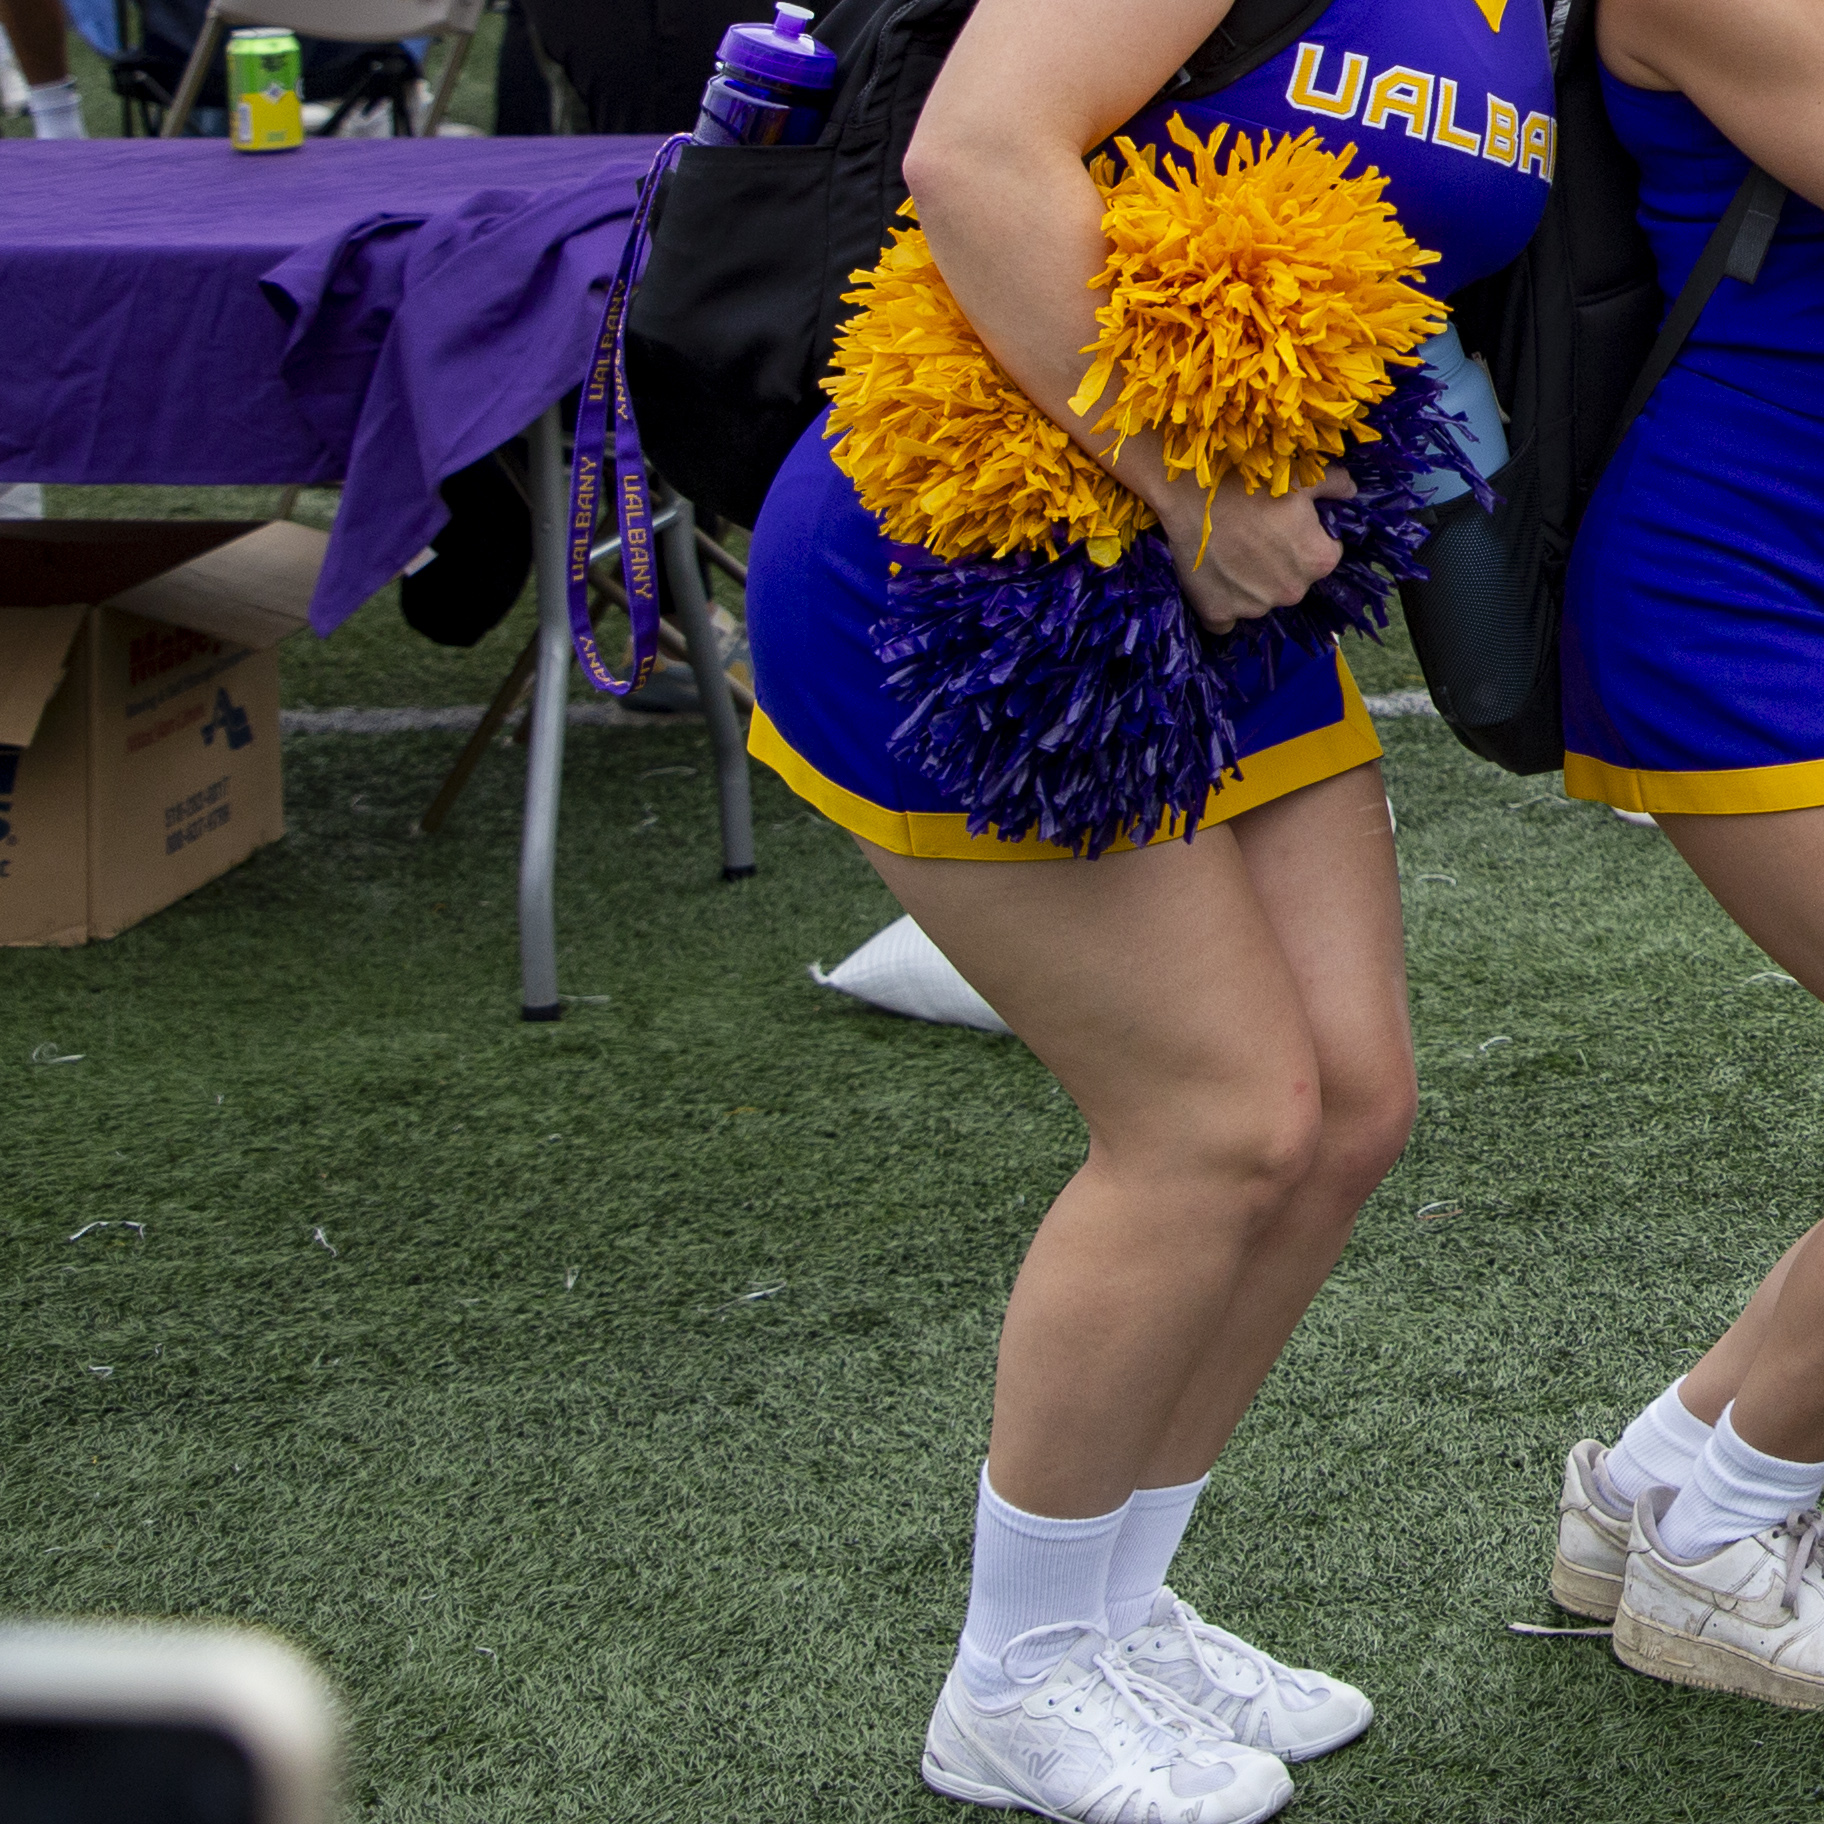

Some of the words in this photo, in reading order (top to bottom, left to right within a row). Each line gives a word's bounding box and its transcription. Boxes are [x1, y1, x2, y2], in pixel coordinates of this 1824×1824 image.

[1286, 41, 1557, 186] UALBA
[588, 279, 626, 402] UALBANY
[572, 456, 597, 582] UALBANY
[623, 475, 653, 600] UALBANY
